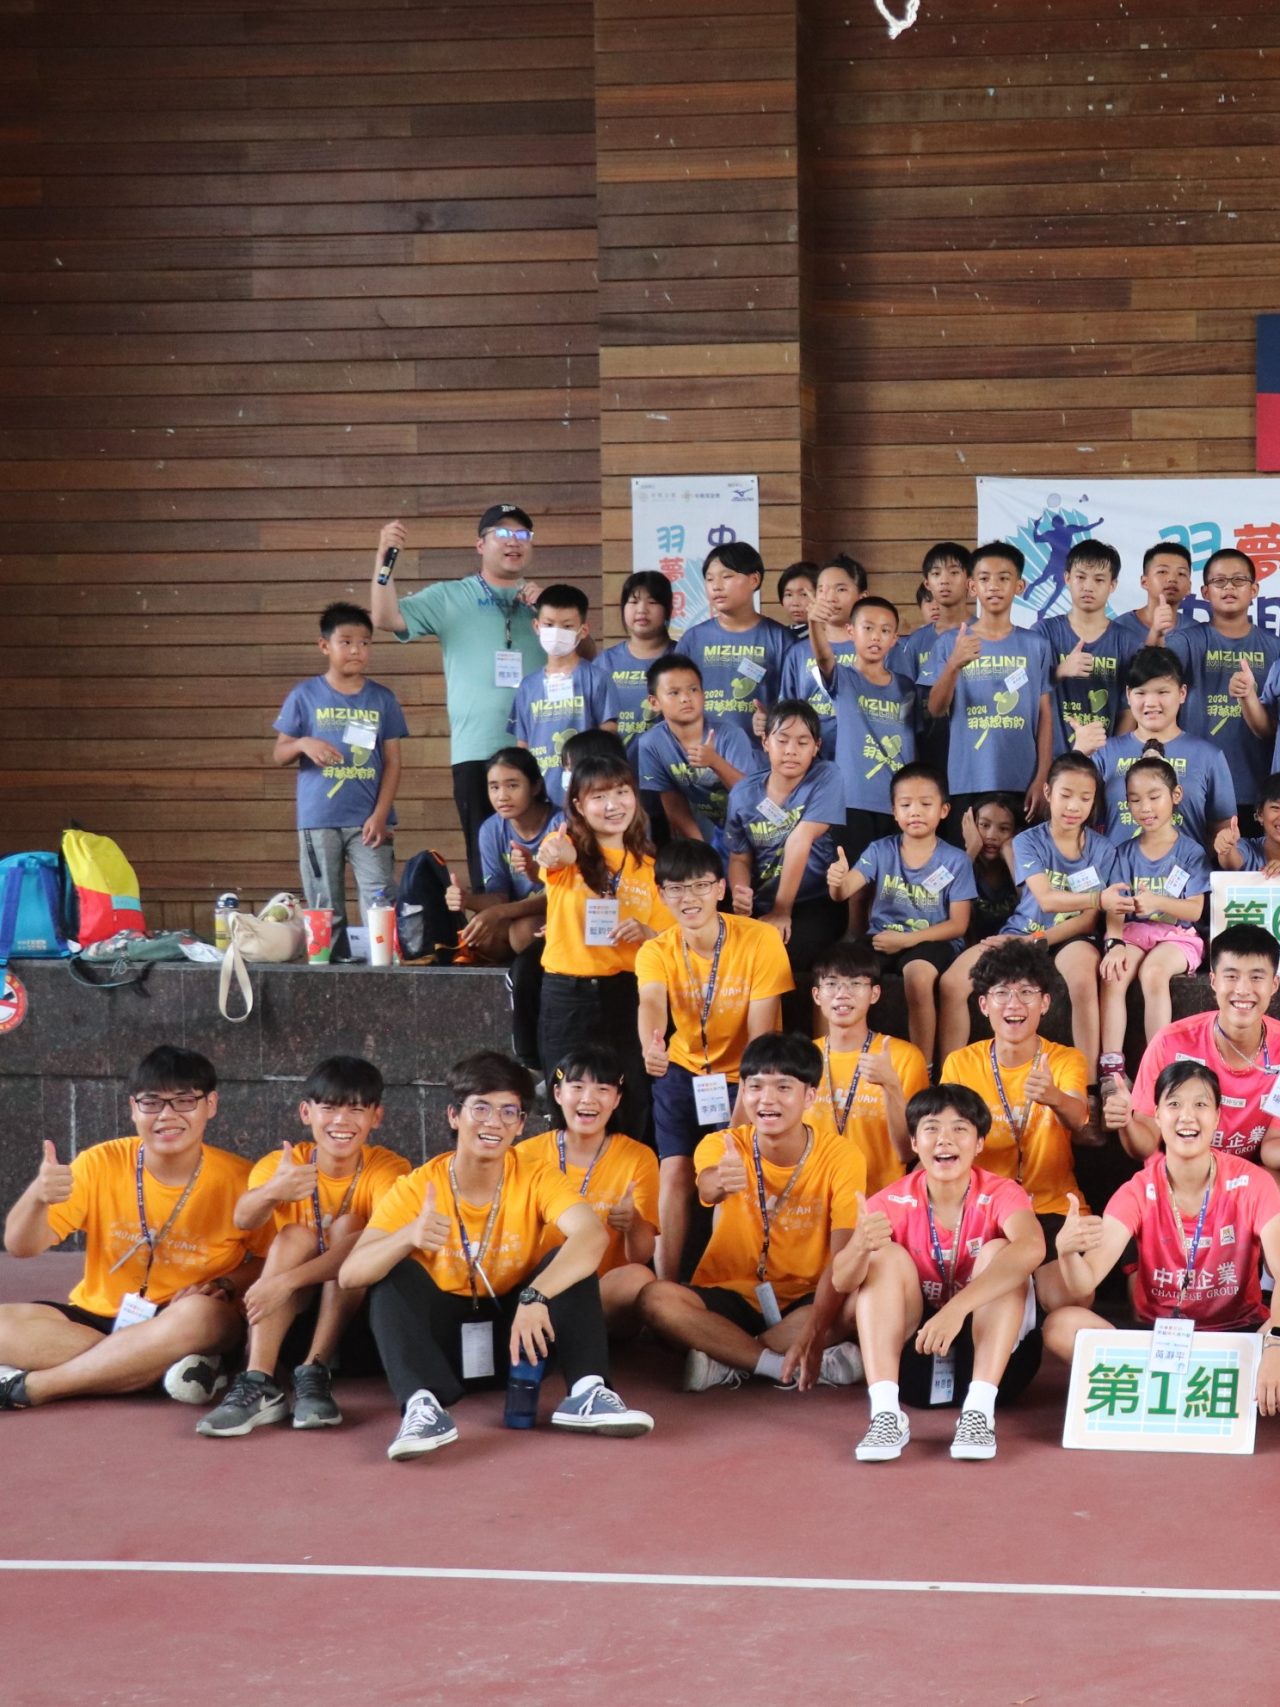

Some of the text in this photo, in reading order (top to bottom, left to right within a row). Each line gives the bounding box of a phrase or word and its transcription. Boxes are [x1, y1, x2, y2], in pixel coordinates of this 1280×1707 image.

[703, 645, 765, 657] MIZUNO
[1207, 650, 1265, 662] MIZUNO
[963, 656, 1027, 668] MIZUNO
[704, 689, 724, 698] 2024
[1207, 695, 1228, 703] 2024
[857, 695, 900, 714] MIZUN
[967, 705, 987, 715] 2024
[316, 707, 379, 722] MIZUNO
[1117, 757, 1187, 768] MINO
[883, 874, 931, 897] MIZUN
[1206, 1285, 1240, 1299] GROUP
[1083, 1362, 1240, 1419] 第1組
